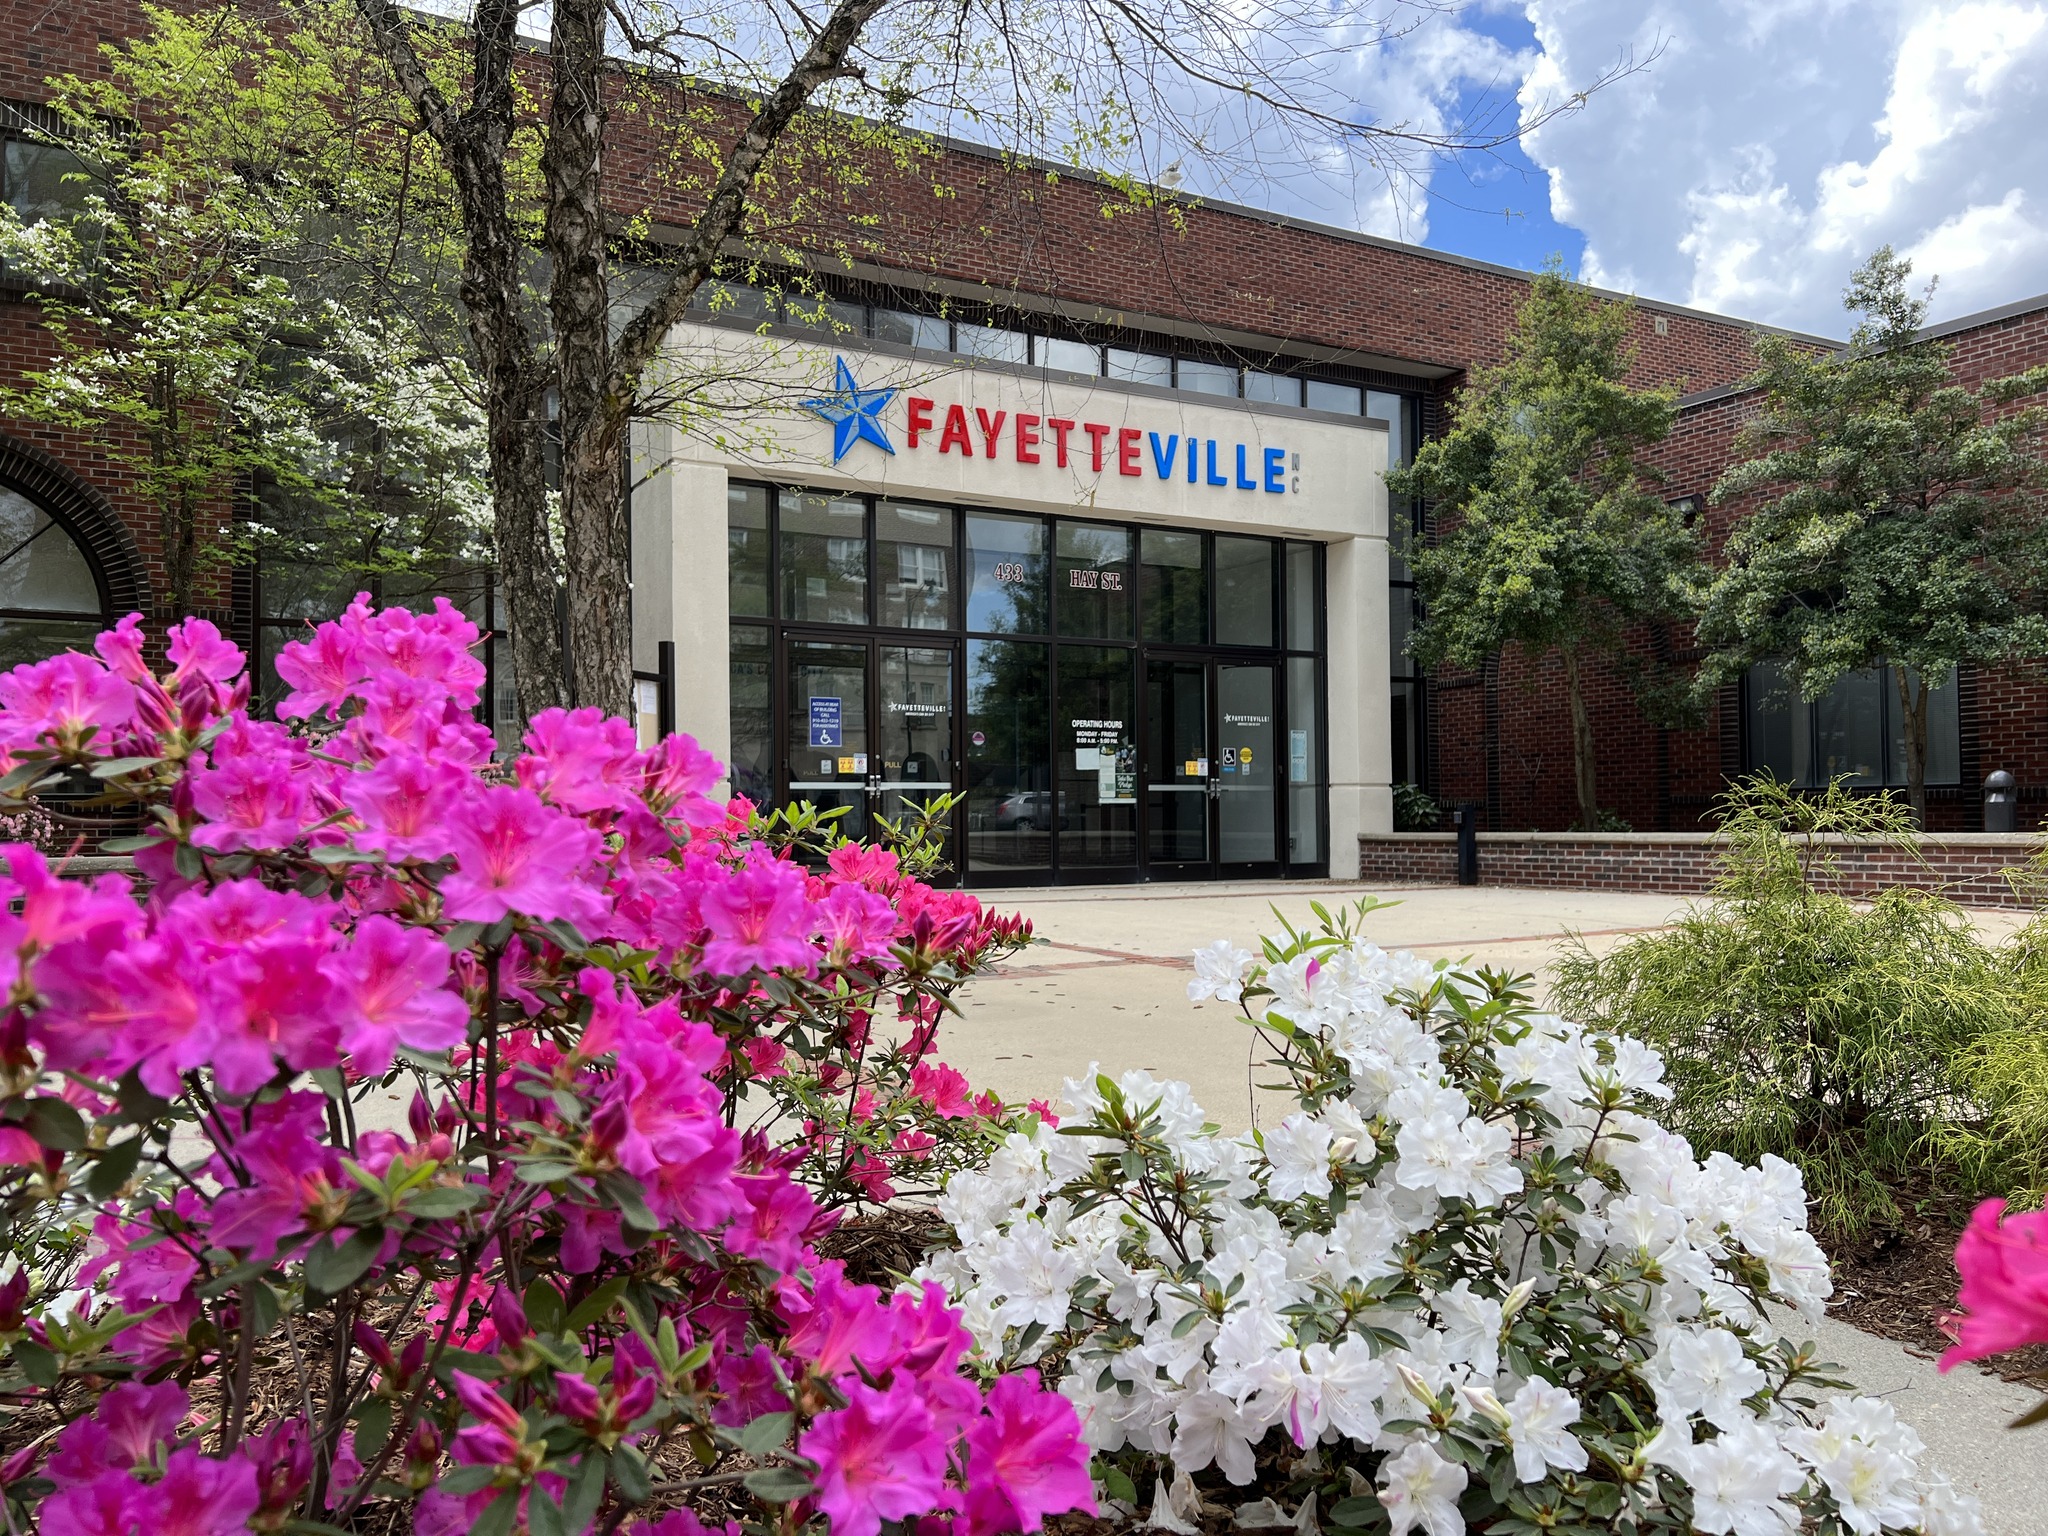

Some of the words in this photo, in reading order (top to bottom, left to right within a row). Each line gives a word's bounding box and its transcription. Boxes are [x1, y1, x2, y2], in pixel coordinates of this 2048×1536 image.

[907, 397, 1286, 493] FAYETTEVILLE
[994, 563, 1023, 583] 433
[1070, 569, 1099, 589] HAY
[1101, 572, 1123, 590] ST.
[1072, 719, 1103, 728] OPERATING
[1103, 720, 1123, 729] HOURS
[884, 761, 902, 769] PULL
